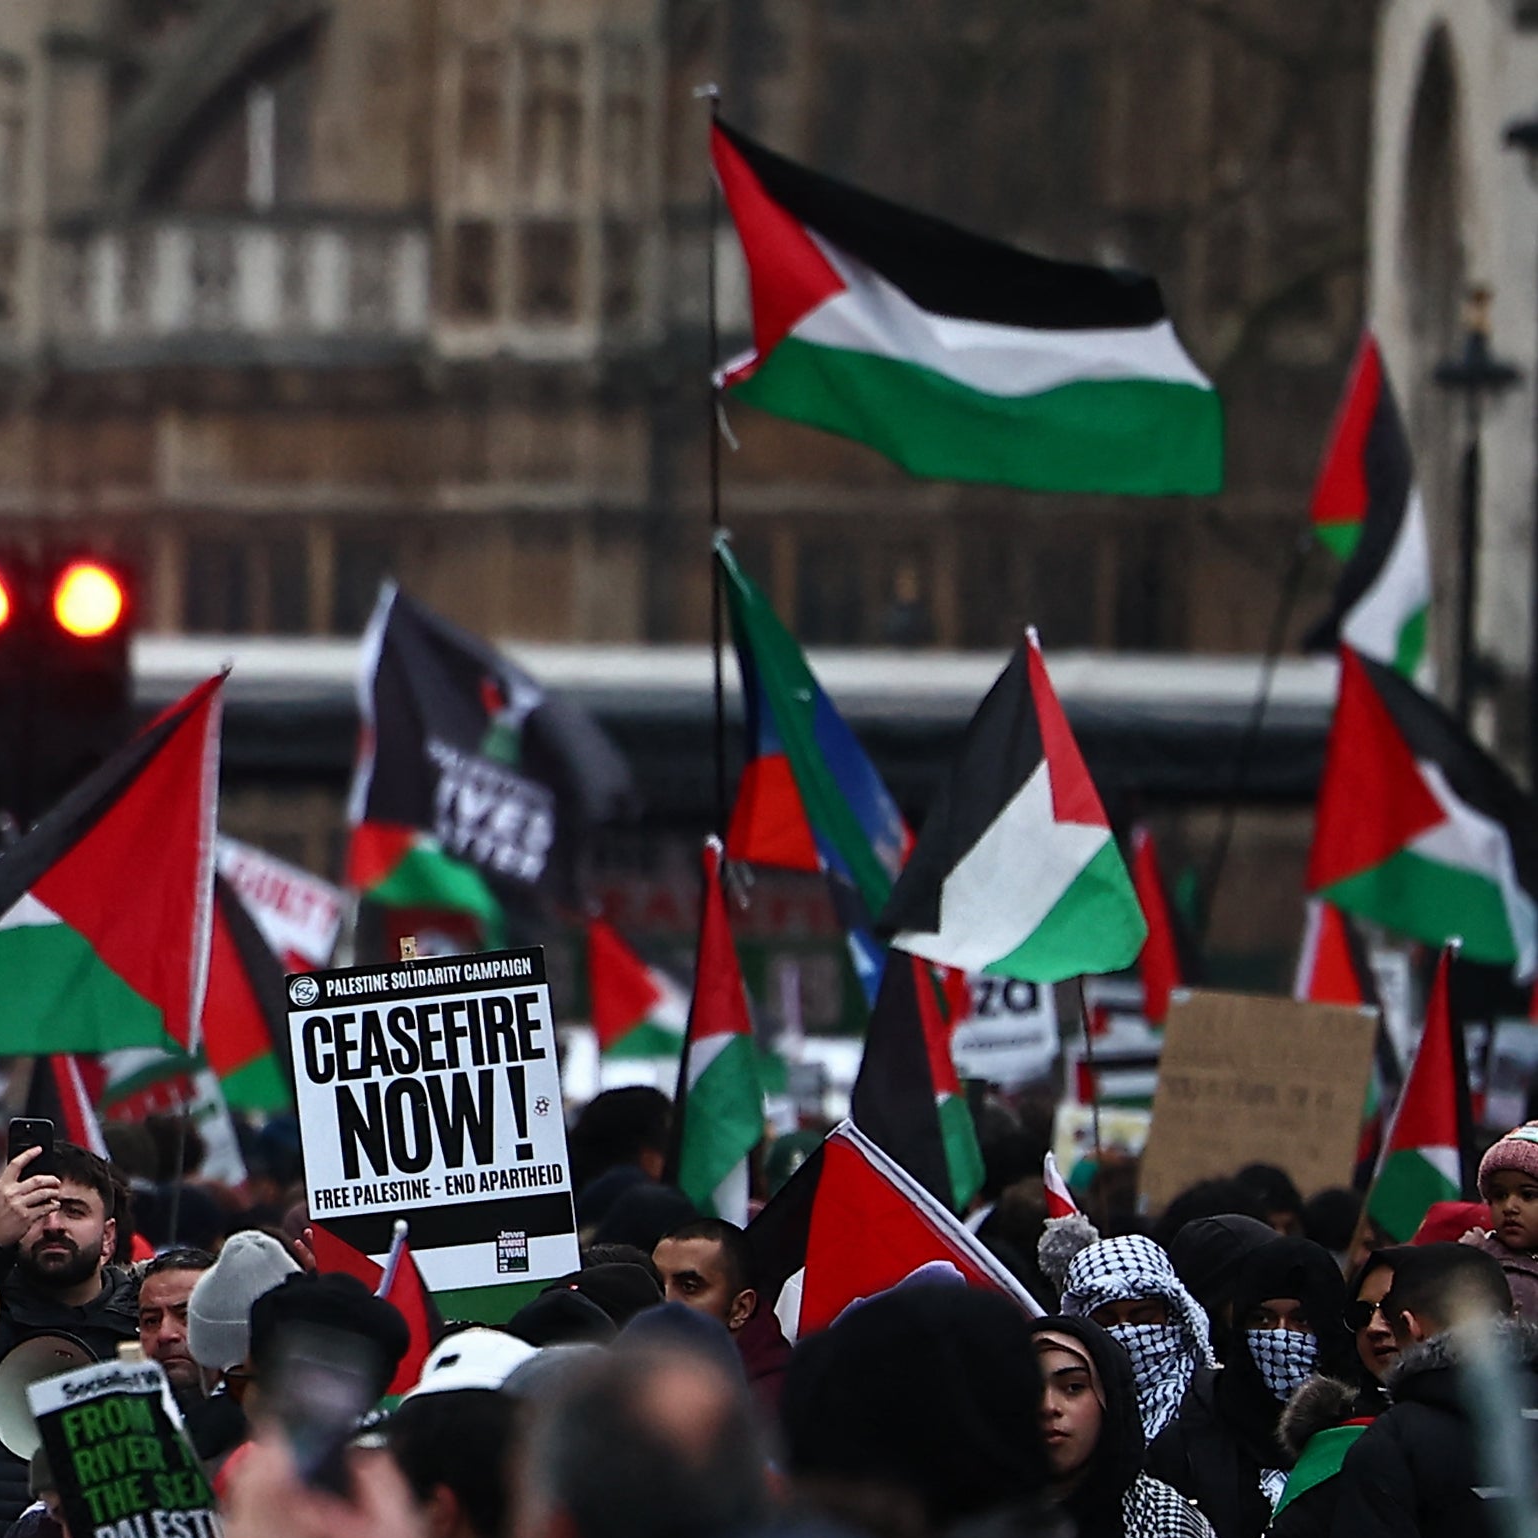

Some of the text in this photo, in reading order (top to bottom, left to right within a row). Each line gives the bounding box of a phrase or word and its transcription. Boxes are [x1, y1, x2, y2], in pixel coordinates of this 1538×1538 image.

[326, 956, 533, 998] PALESTINE SOLIDARITY CAMPAIGN
[302, 992, 546, 1085] CEASEFIRE
[314, 1186, 351, 1211] FREE
[354, 1177, 432, 1206] PALESTINE
[445, 1173, 476, 1196] END
[479, 1163, 564, 1192] APARTHEID
[61, 1398, 157, 1450] FROM
[73, 1435, 167, 1488] RIVER
[82, 1473, 151, 1525] THE
